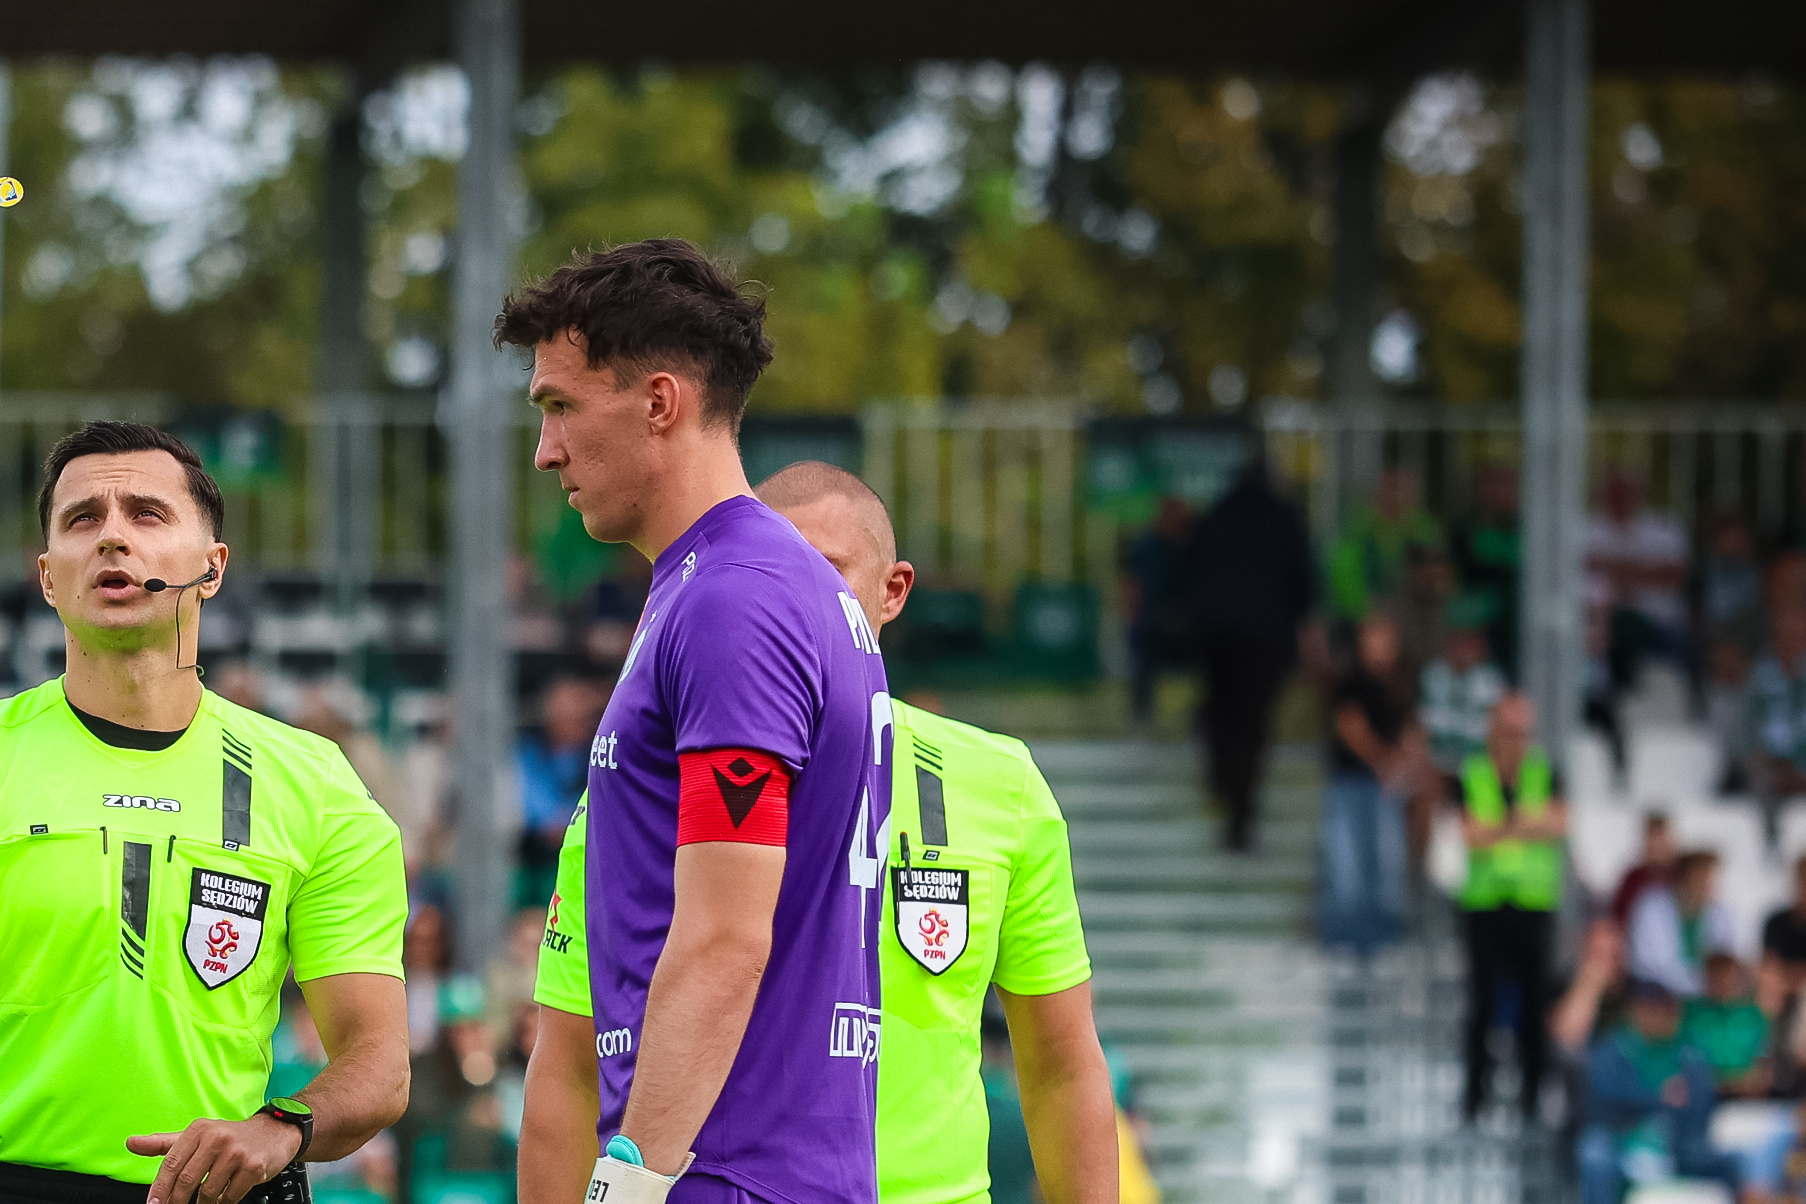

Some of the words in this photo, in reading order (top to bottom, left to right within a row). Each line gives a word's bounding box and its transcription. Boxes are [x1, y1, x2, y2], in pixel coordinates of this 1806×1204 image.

[102, 793, 181, 812] zina
[200, 872, 263, 900] KOLEGIUM
[201, 888, 259, 914] SĘDZIÓW
[923, 948, 946, 960] PZPN
[202, 958, 228, 974] PZPN
